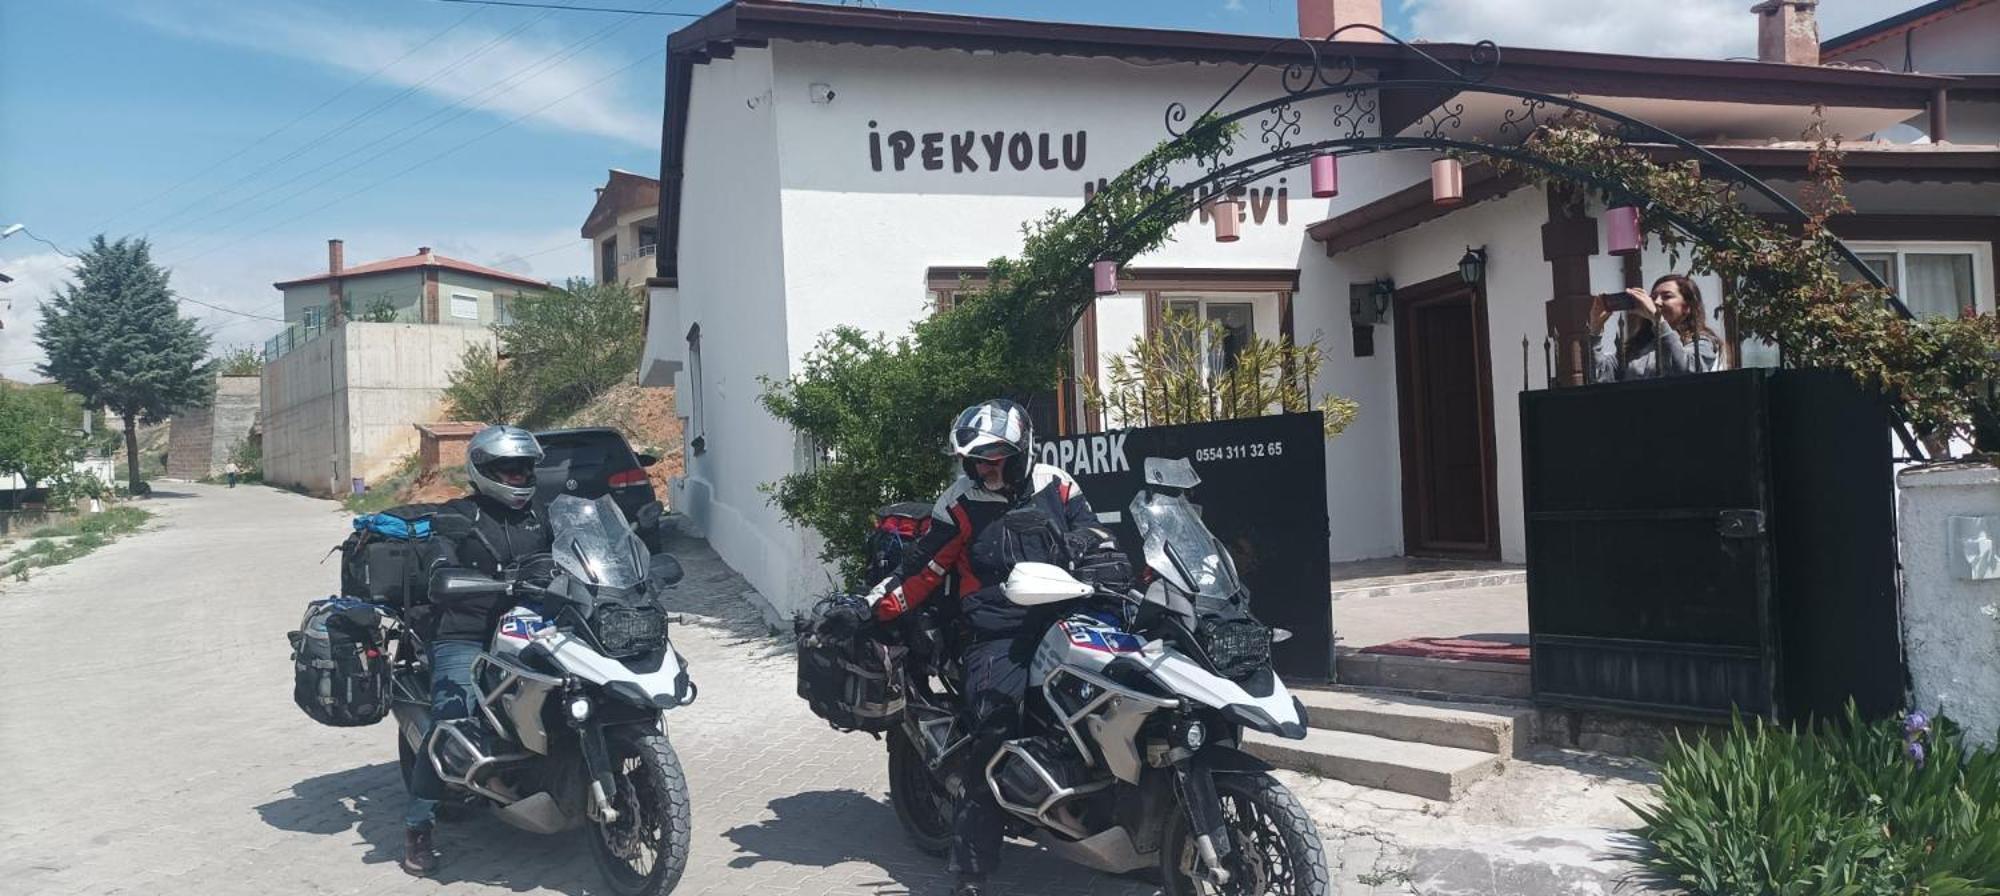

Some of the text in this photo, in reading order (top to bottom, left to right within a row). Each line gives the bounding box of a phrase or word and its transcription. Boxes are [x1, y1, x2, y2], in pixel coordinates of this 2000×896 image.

[868, 120, 1087, 173] İPEKYOLU
[1033, 433, 1130, 475] OPARK
[1195, 441, 1282, 461] 0554 311 32 65
